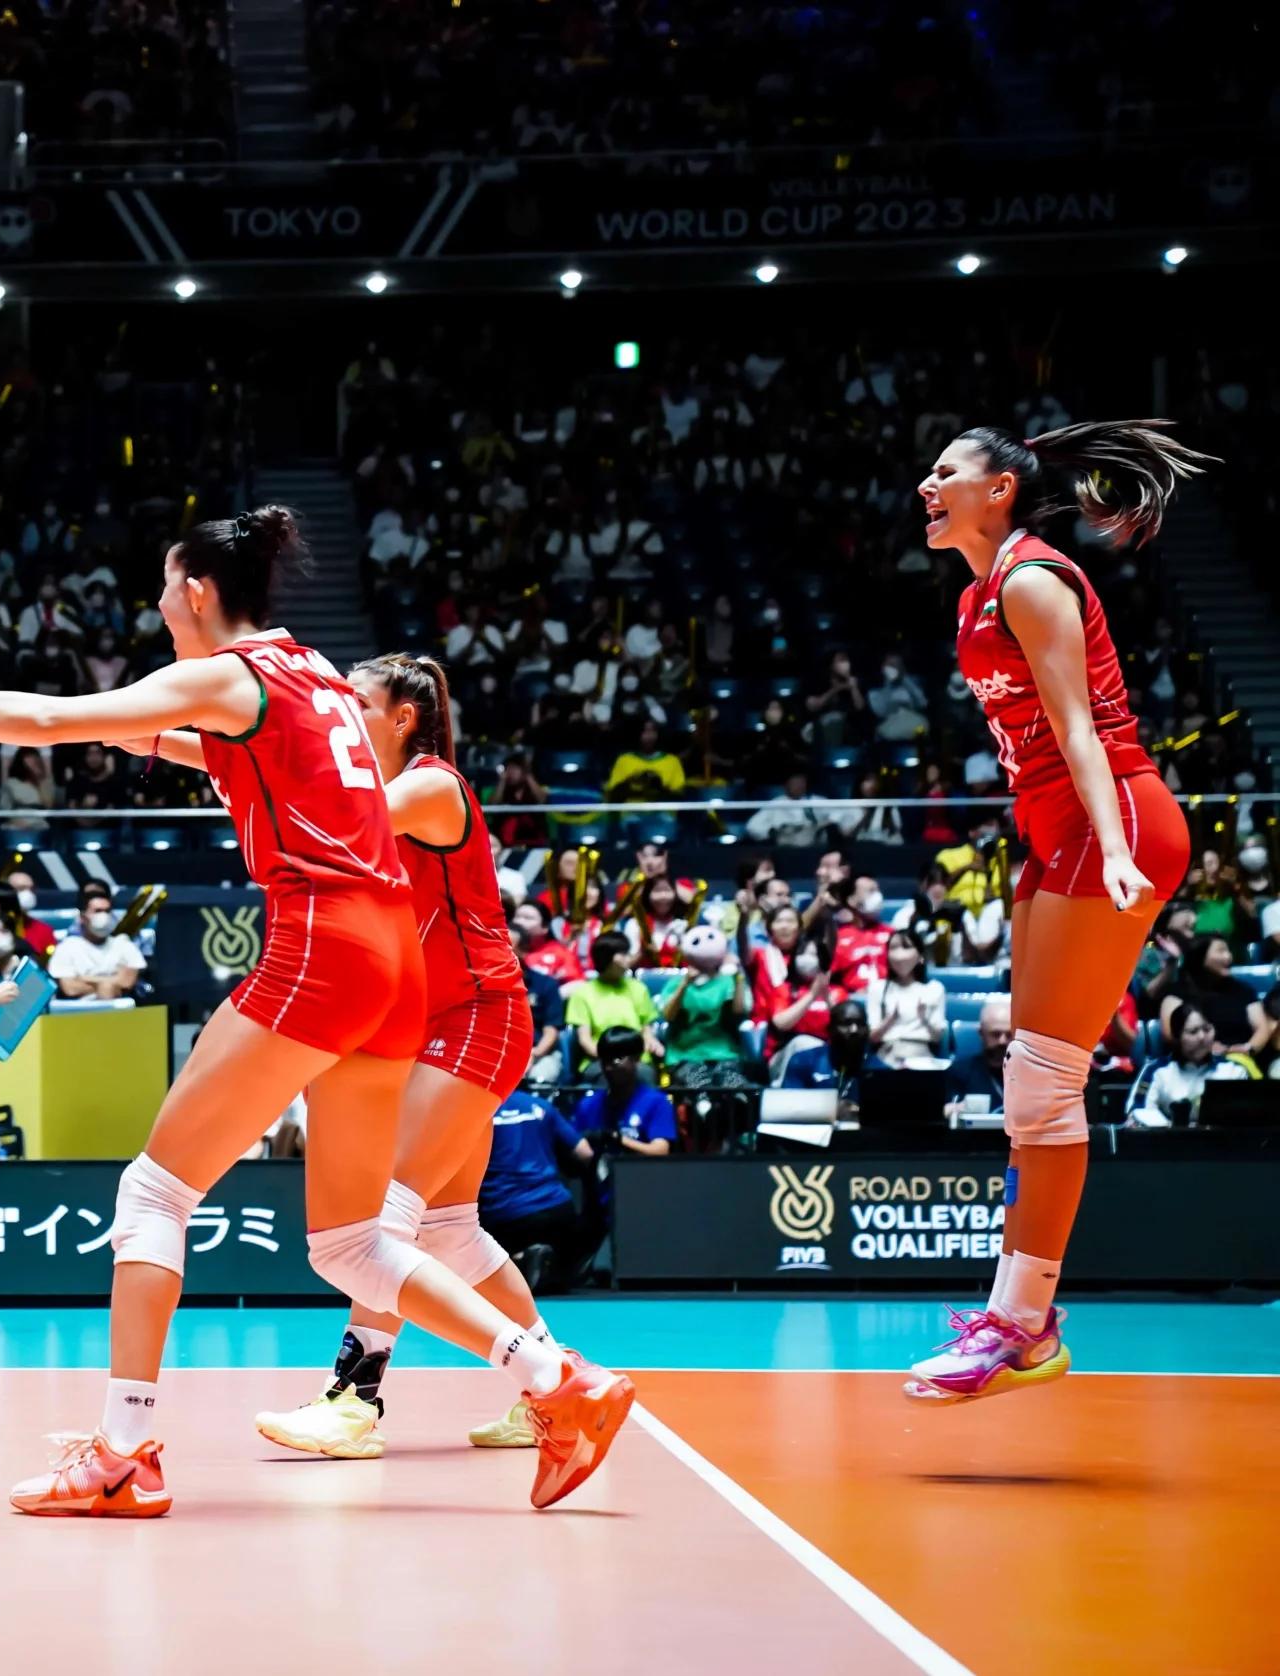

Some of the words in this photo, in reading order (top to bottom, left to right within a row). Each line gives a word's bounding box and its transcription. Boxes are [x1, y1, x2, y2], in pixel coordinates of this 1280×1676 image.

[767, 177, 933, 199] VOLLEYBALL
[224, 206, 361, 238] TOKYO
[597, 207, 749, 241] WORLD
[760, 203, 843, 237] CUP
[855, 198, 967, 233] 2023
[979, 192, 1117, 226] JAPAN
[850, 1176, 931, 1200] ROAD
[939, 1176, 978, 1200] TO
